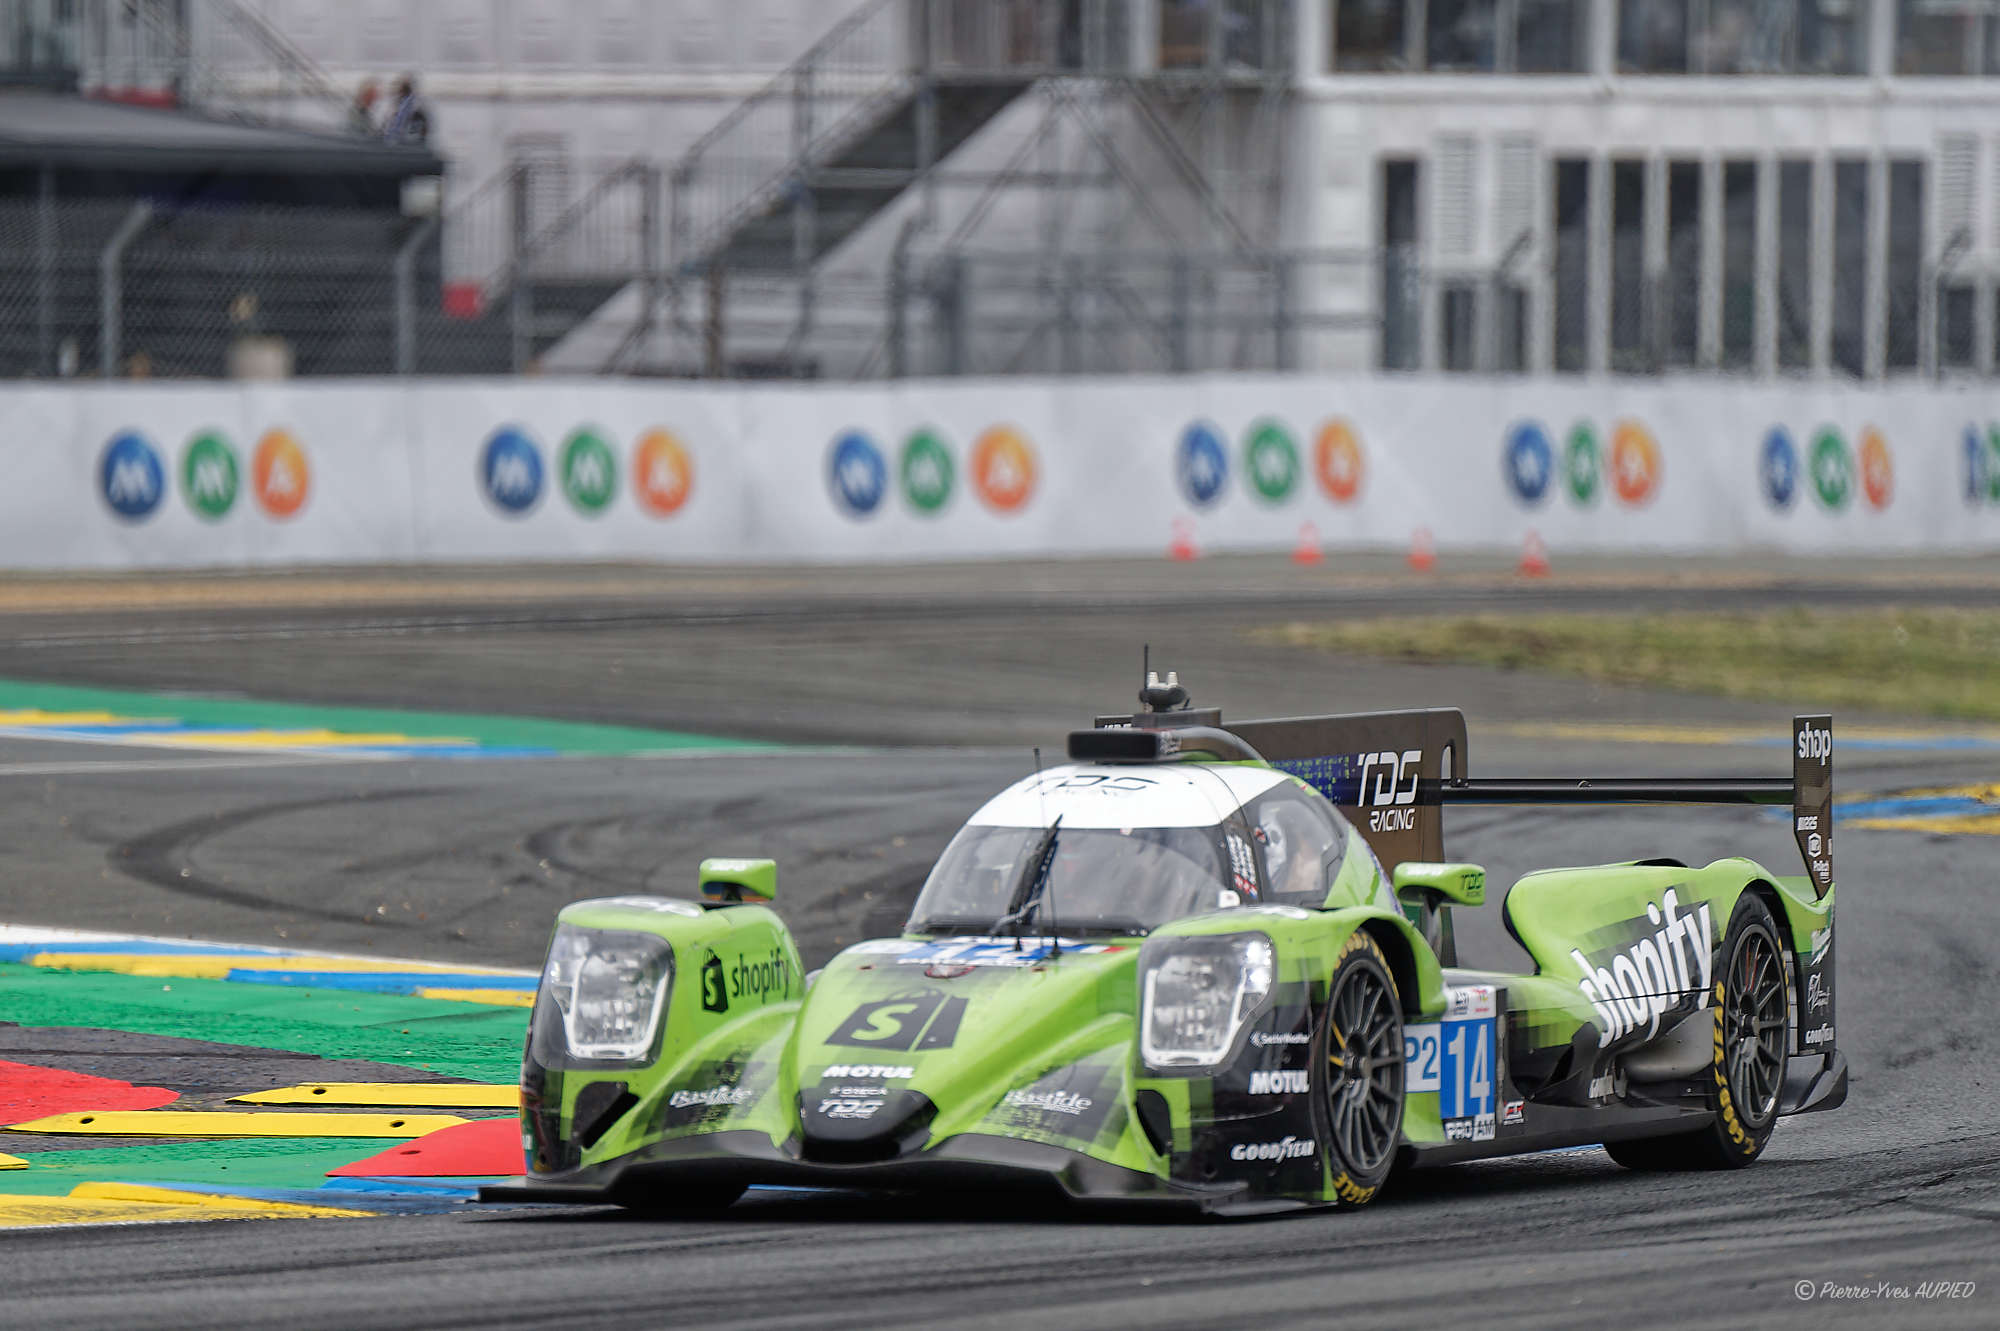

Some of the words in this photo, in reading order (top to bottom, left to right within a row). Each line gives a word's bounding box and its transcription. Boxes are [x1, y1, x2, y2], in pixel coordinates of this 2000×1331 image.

[1798, 722, 1832, 766] shop
[1357, 750, 1423, 808] TDS
[1369, 808, 1416, 832] RACING
[731, 947, 790, 1004] shopify
[1570, 886, 1712, 1049] shopify
[822, 1065, 915, 1079] MOTUL
[1249, 1070, 1310, 1095] MOTUL
[1447, 1023, 1491, 1119] 14
[1445, 1121, 1473, 1141] PRO
[1476, 1119, 1494, 1139] AM
[1231, 1136, 1315, 1163] GOODYEAR
